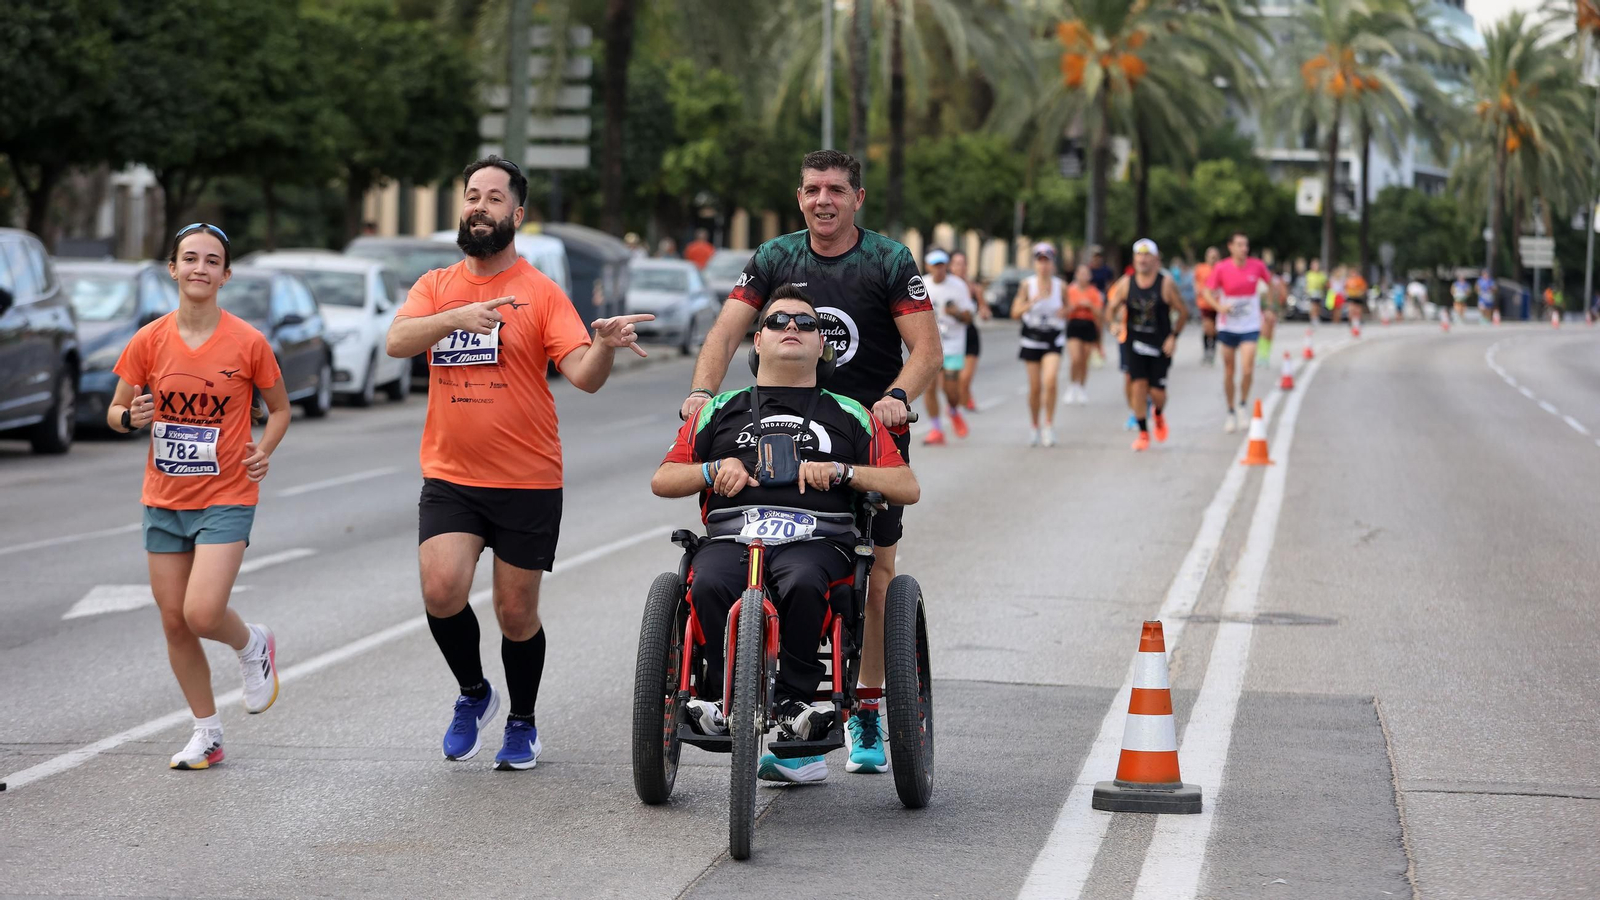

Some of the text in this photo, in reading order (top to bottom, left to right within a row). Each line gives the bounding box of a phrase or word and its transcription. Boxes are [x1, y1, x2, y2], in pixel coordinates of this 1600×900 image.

[447, 331, 481, 349] 794
[166, 441, 199, 460] 782
[756, 520, 796, 538] 670
